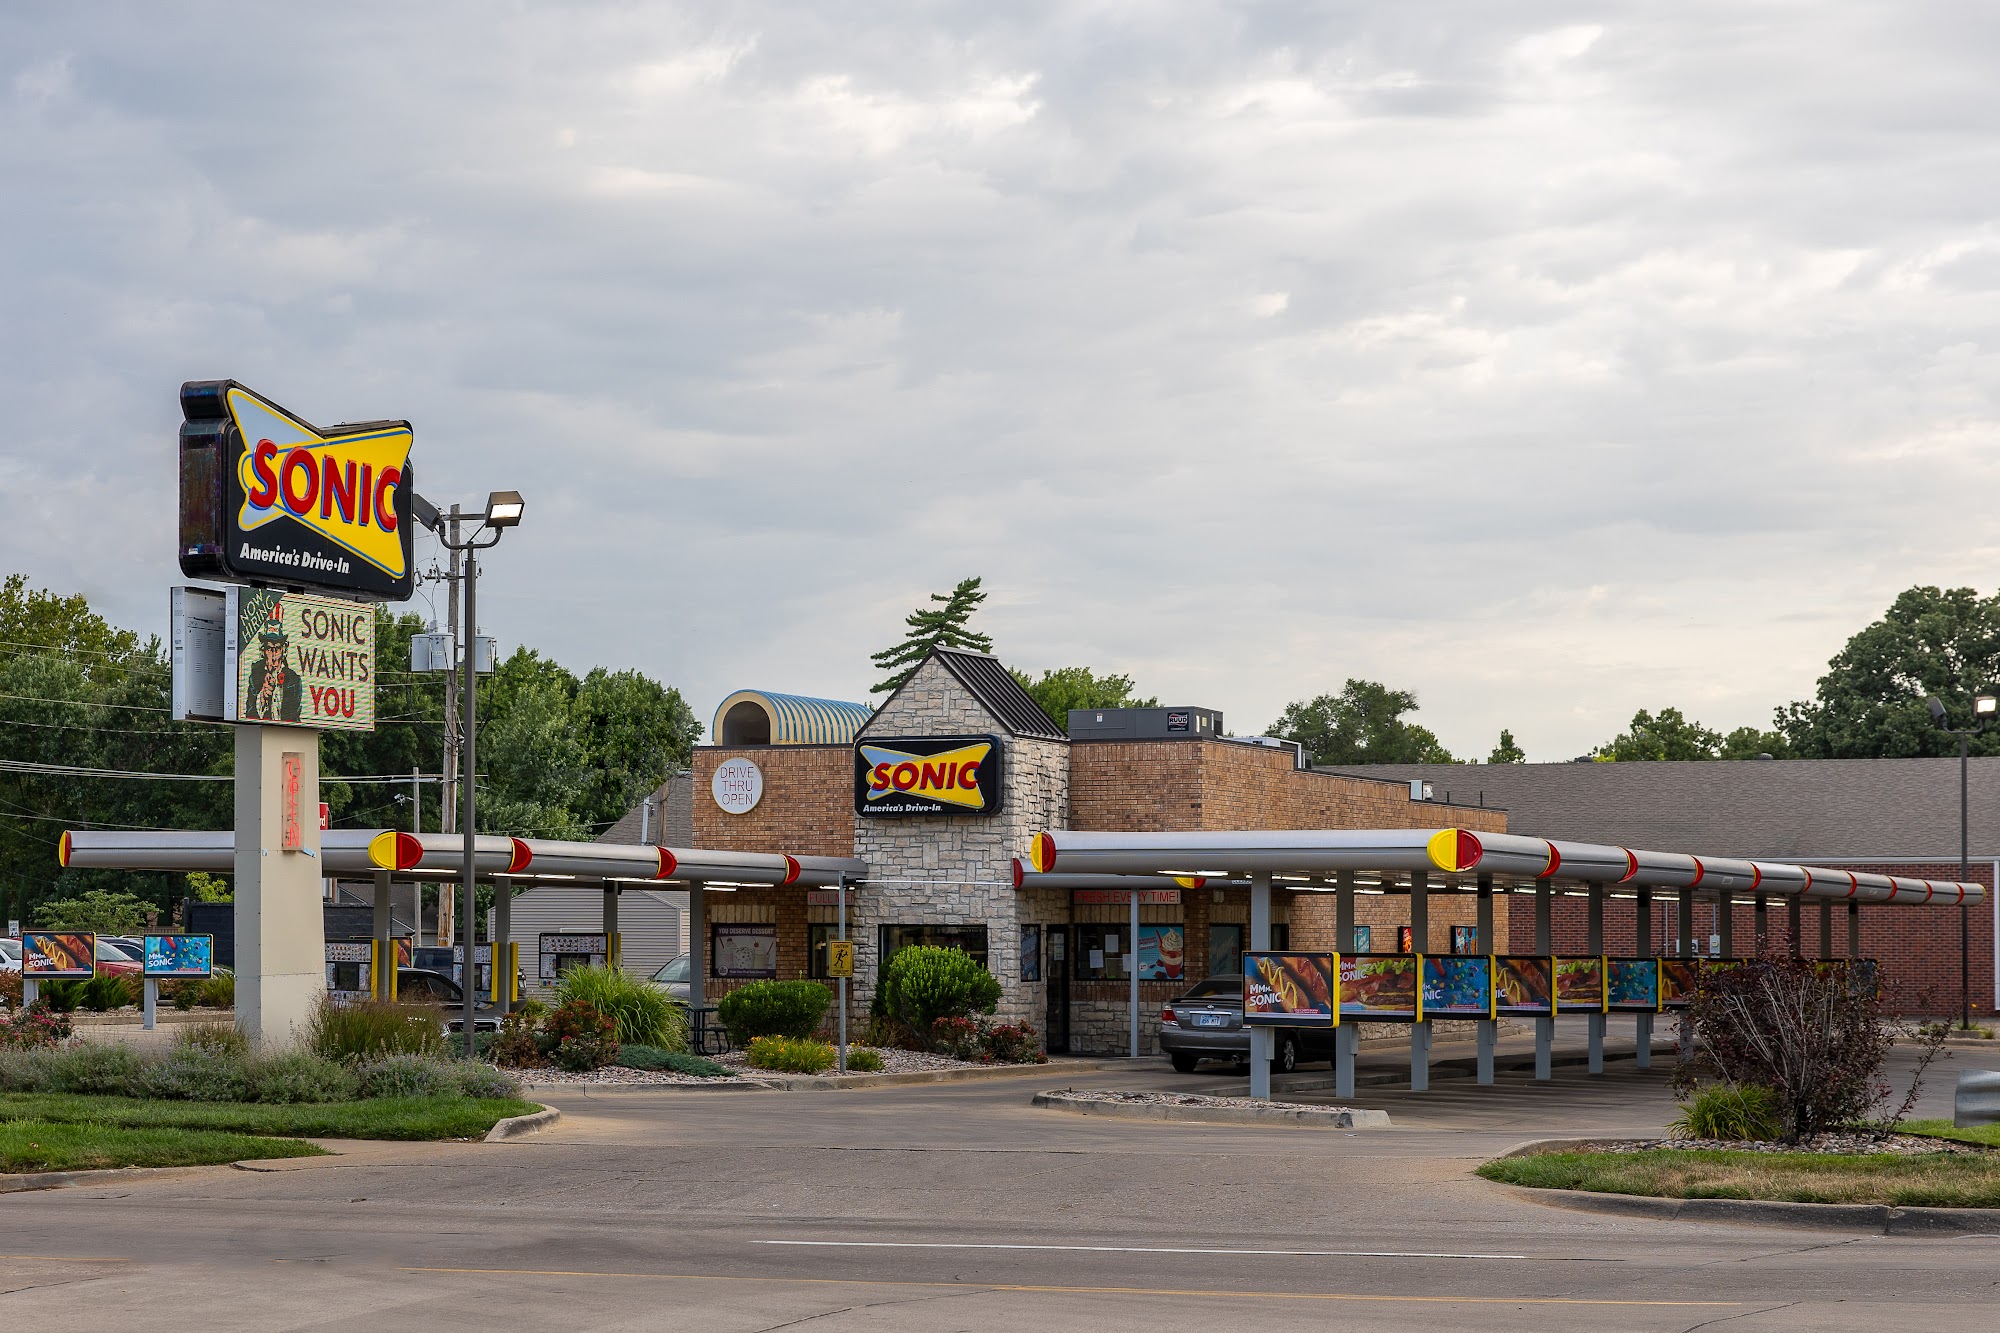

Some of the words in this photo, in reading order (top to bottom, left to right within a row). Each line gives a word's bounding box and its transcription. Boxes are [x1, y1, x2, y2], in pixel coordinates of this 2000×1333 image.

[249, 438, 400, 532] SONIC
[239, 542, 300, 567] America's
[240, 588, 263, 626] NOW
[242, 595, 275, 644] HIRING
[301, 608, 366, 645] SONIC
[297, 645, 369, 683] WANTS
[309, 685, 355, 719] YOU
[720, 765, 754, 779] DRIVE
[721, 779, 754, 792] THRU
[870, 761, 981, 792] SONIC
[721, 792, 754, 806] OPEN
[863, 803, 904, 812] America's
[809, 893, 832, 904] FULL
[1075, 892, 1110, 903] FRESH
[1151, 891, 1180, 902] TIME!
